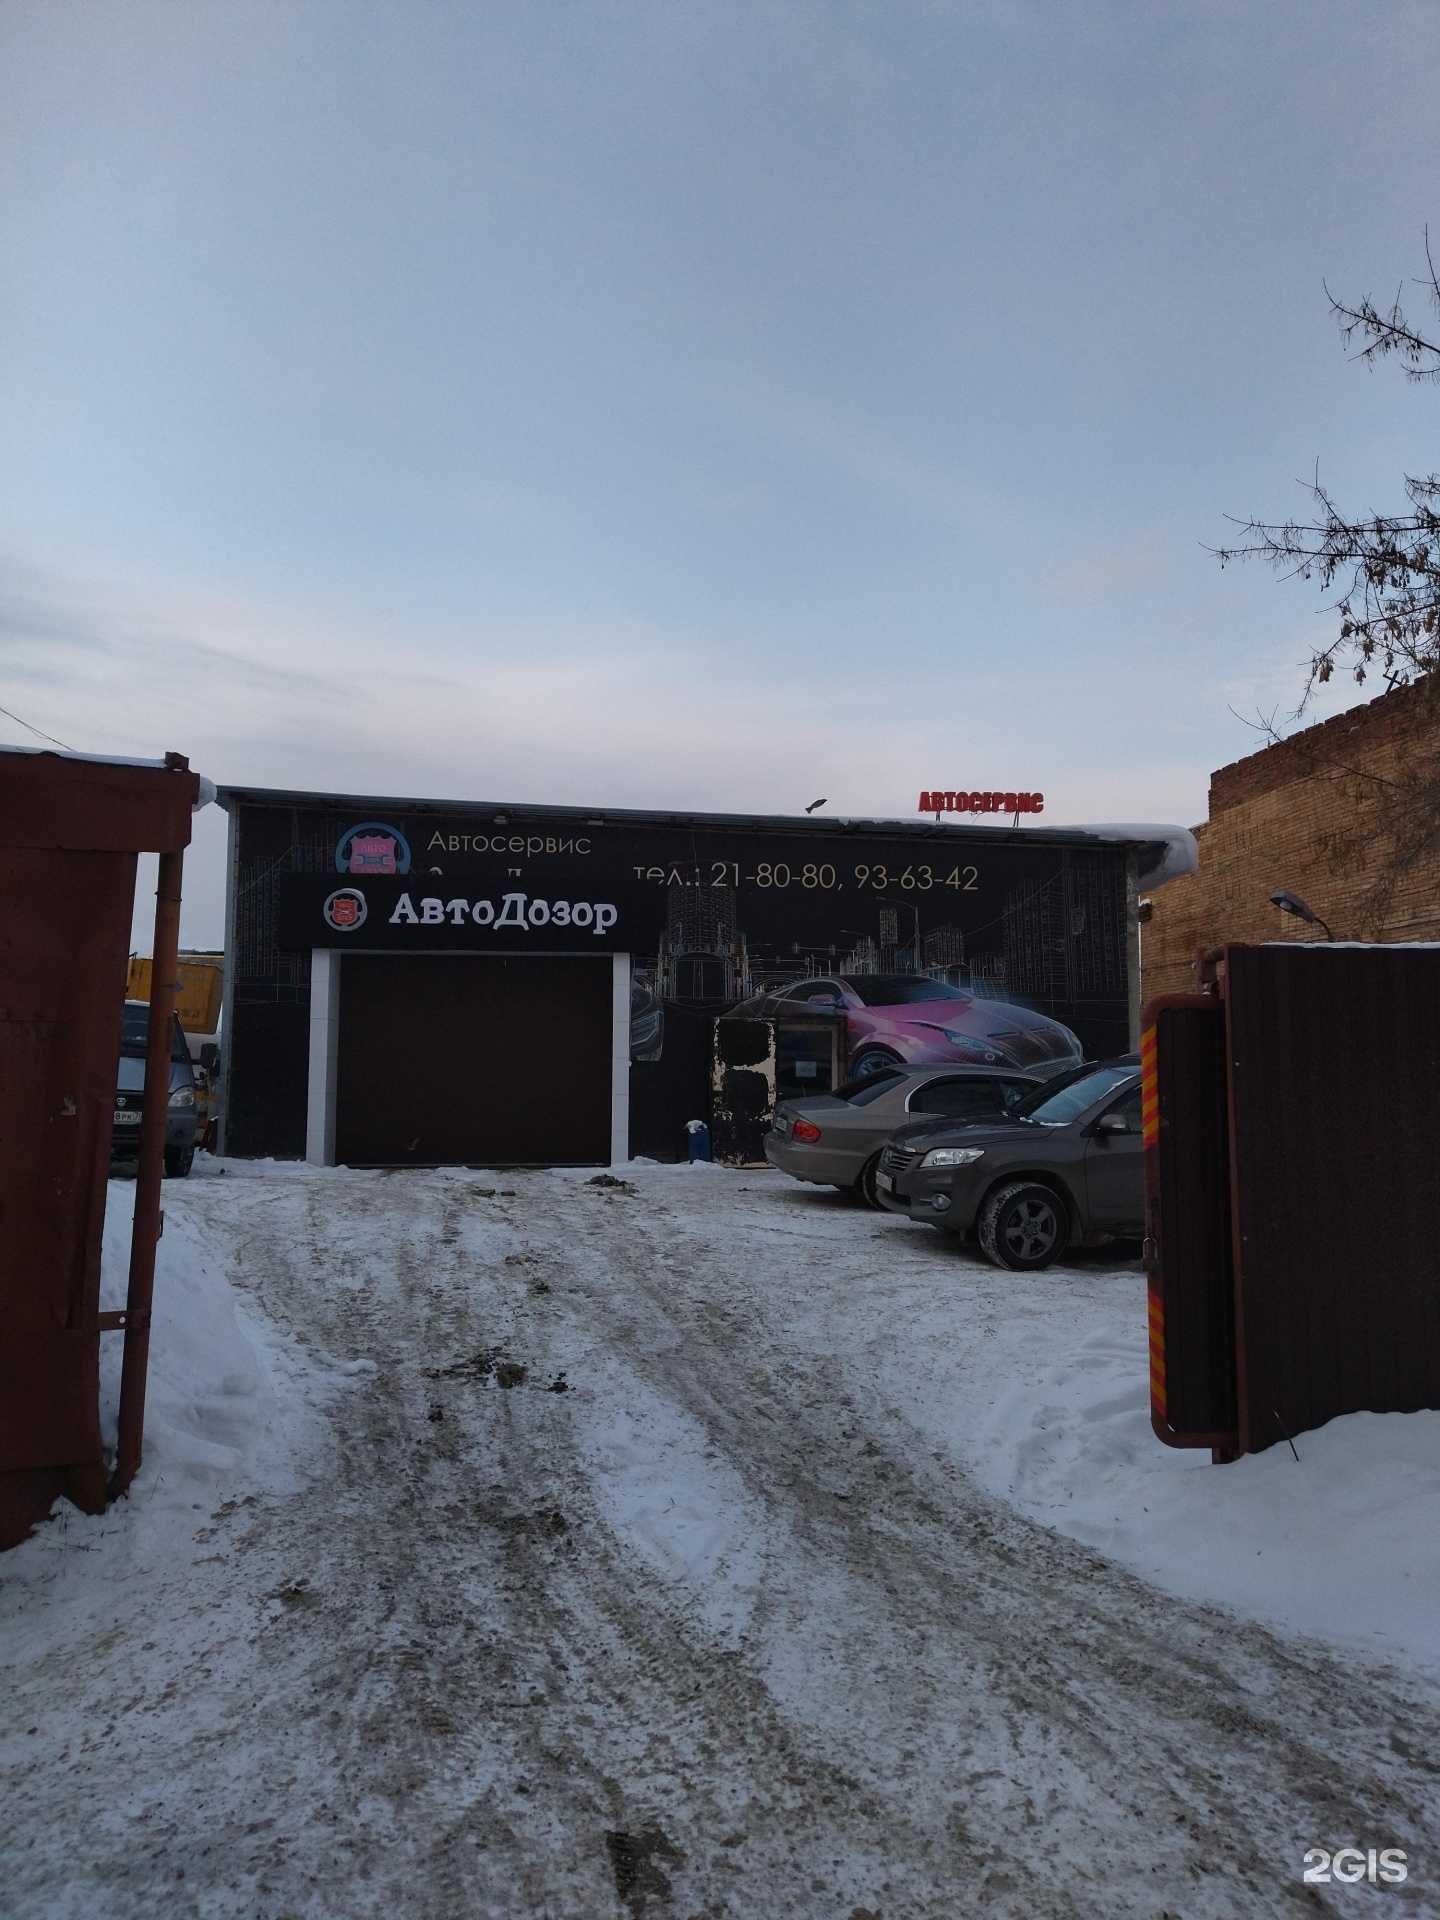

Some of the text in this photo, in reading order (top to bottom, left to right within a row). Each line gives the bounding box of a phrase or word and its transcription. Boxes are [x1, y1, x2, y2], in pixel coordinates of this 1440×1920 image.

[919, 792, 1044, 813] АВТОСЕРВИС
[427, 831, 592, 858] Автосервис
[711, 862, 843, 891] 21-80-80,
[854, 865, 980, 892] 93-63-42
[388, 892, 618, 935] АвтоДозор
